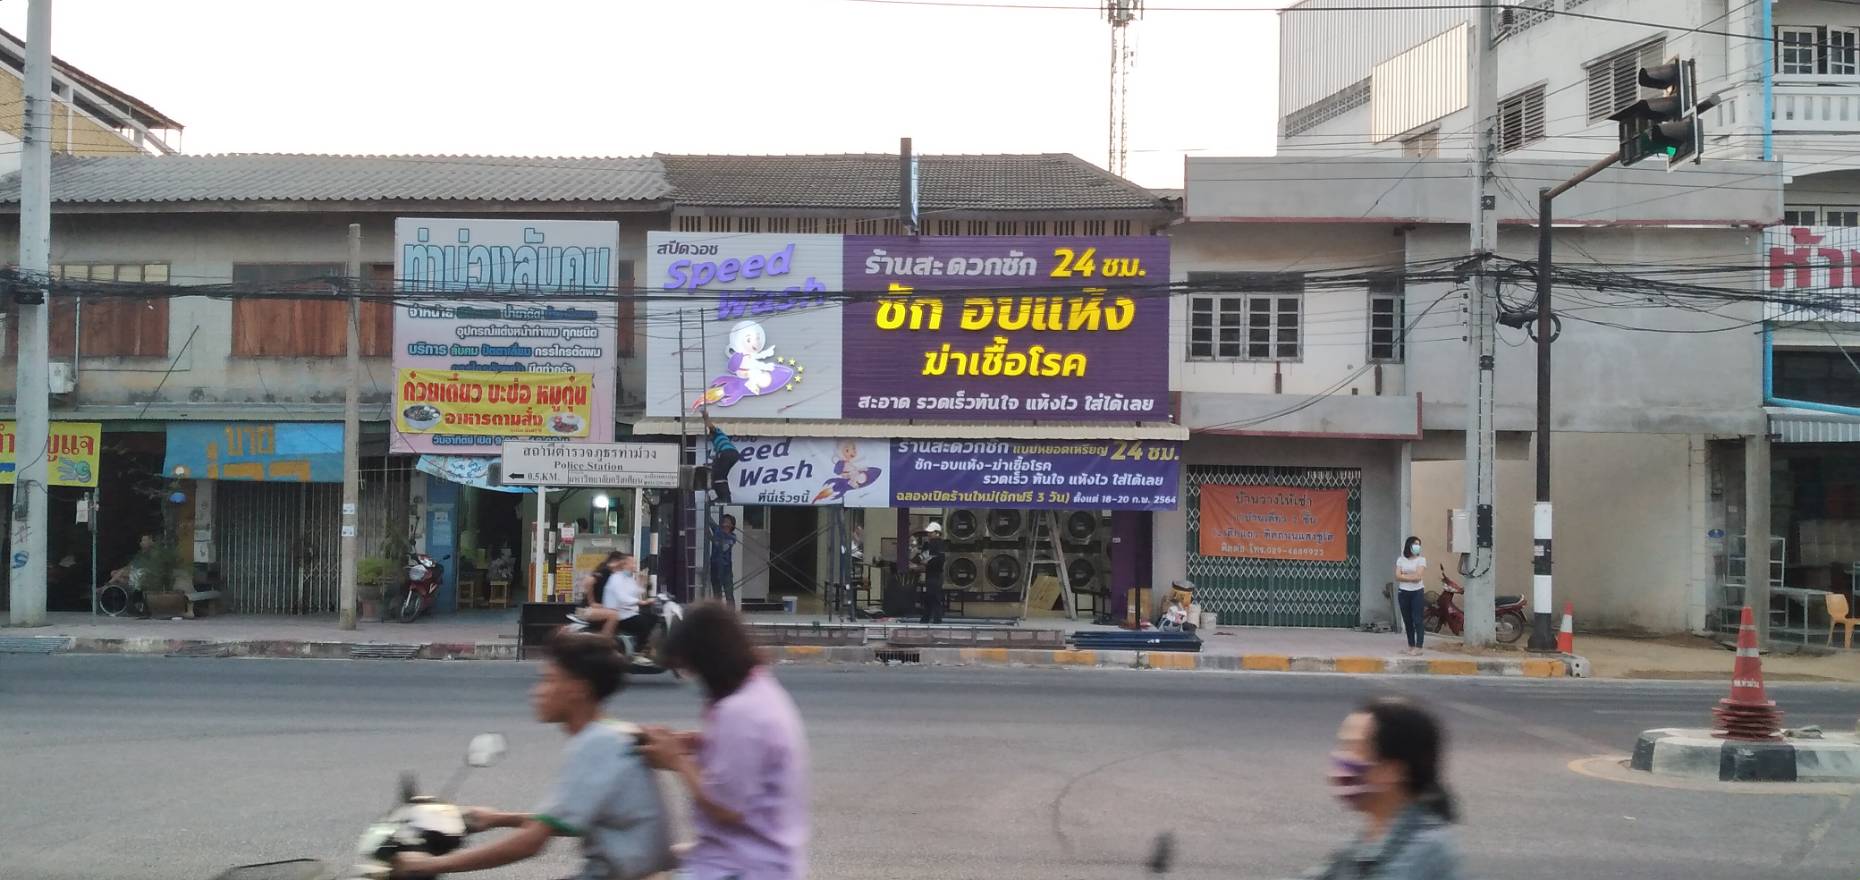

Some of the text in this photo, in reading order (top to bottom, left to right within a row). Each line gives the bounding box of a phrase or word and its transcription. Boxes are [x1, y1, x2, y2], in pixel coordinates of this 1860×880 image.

[656, 240, 719, 256] สปีดวอช
[664, 243, 796, 294] Speed
[864, 247, 1147, 278] ร้านสะดวกซัก 24 ชม.
[717, 277, 826, 320] Wash
[875, 282, 1136, 331] ซัก อบแห้ง
[456, 325, 598, 340] อุปกรณ์แต่งหน้าทำผม ทุกชนิด
[408, 341, 447, 356] บริการ
[921, 335, 1088, 377] ฆ่าเชื้อโรค
[403, 371, 483, 403] ก๋วยเตี๋ยว
[537, 376, 587, 412] หมูตุ๋น
[858, 390, 1155, 412] สะอาด รวดเร็วทันใจ แห้งไว ใส่ได้เลย
[444, 406, 544, 427] อาหารตามสั่ง
[523, 443, 657, 461] สถานีตำรวจภูธรท่าม่วง
[738, 437, 792, 462] eed
[1110, 440, 1143, 460] 24
[1147, 447, 1180, 461] ชม.
[554, 461, 623, 471] Police Station
[739, 459, 813, 487] Wash
[983, 471, 1163, 486] รวดเร็ว ทันใจ แห้งไว ใส่ได้เลย
[1037, 492, 1045, 502] 3
[1049, 491, 1070, 504] วัน)
[1073, 492, 1099, 503] ตั้งแต่
[1132, 495, 1150, 504] ก.พ.
[1153, 495, 1176, 504] 2564
